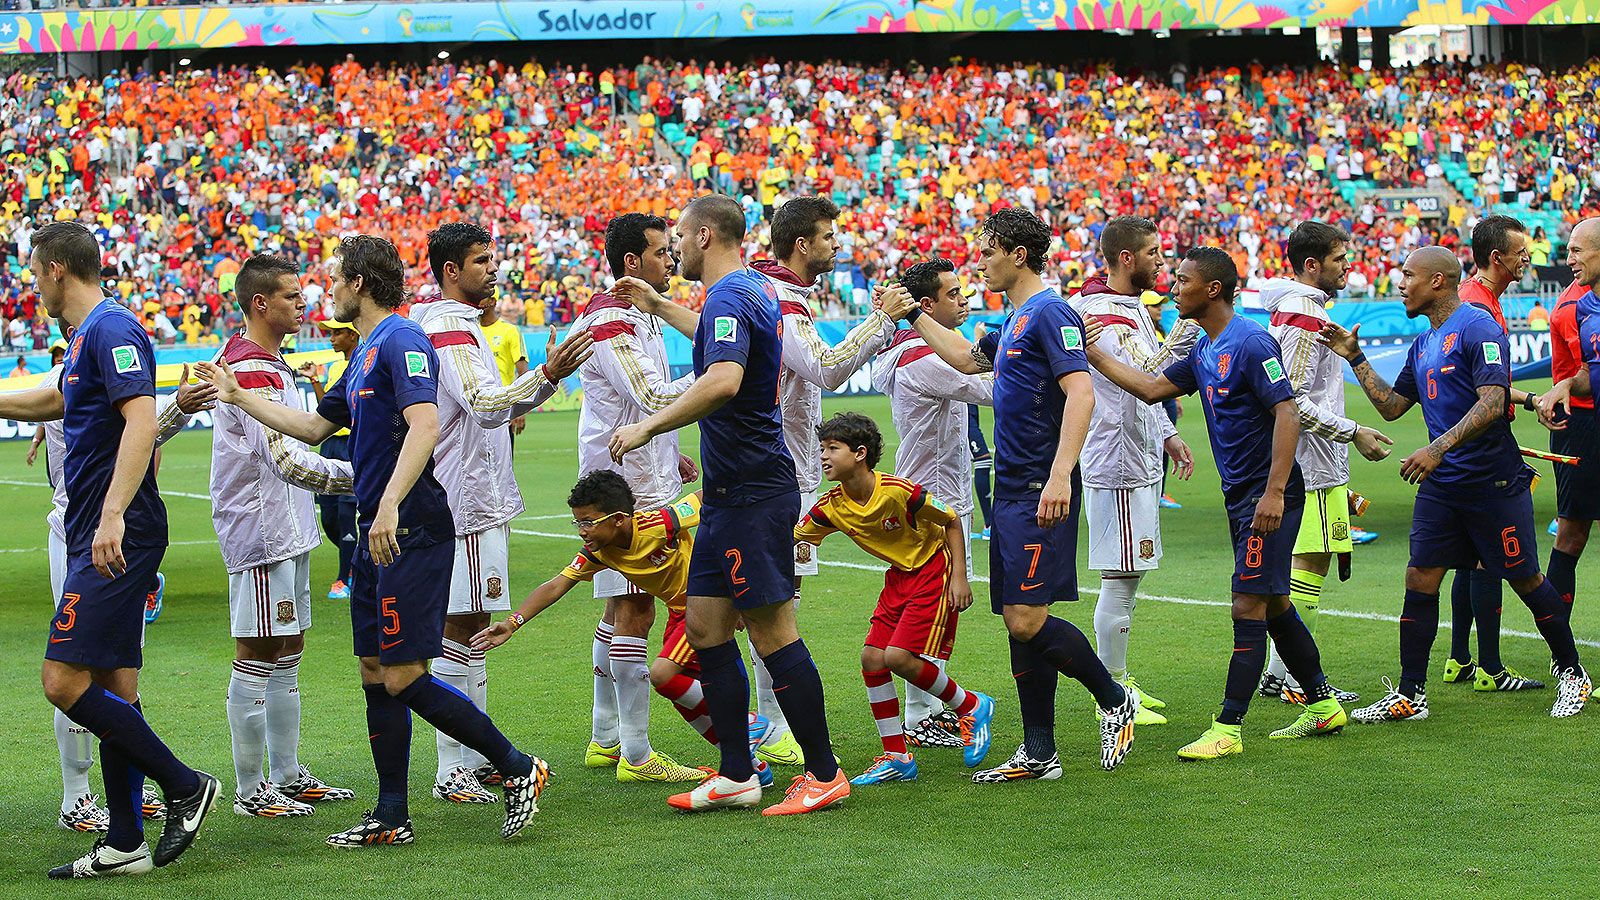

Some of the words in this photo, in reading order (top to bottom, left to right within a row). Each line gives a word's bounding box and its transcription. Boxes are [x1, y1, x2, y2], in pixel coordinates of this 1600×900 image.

[538, 7, 657, 32] Salvador
[1415, 197, 1438, 211] 103
[1426, 368, 1438, 400] 6
[1246, 536, 1263, 568] 8
[1502, 527, 1520, 557] 6
[726, 549, 746, 585] 2
[1024, 544, 1042, 579] 7
[56, 593, 81, 632] 3
[382, 597, 401, 635] 5
